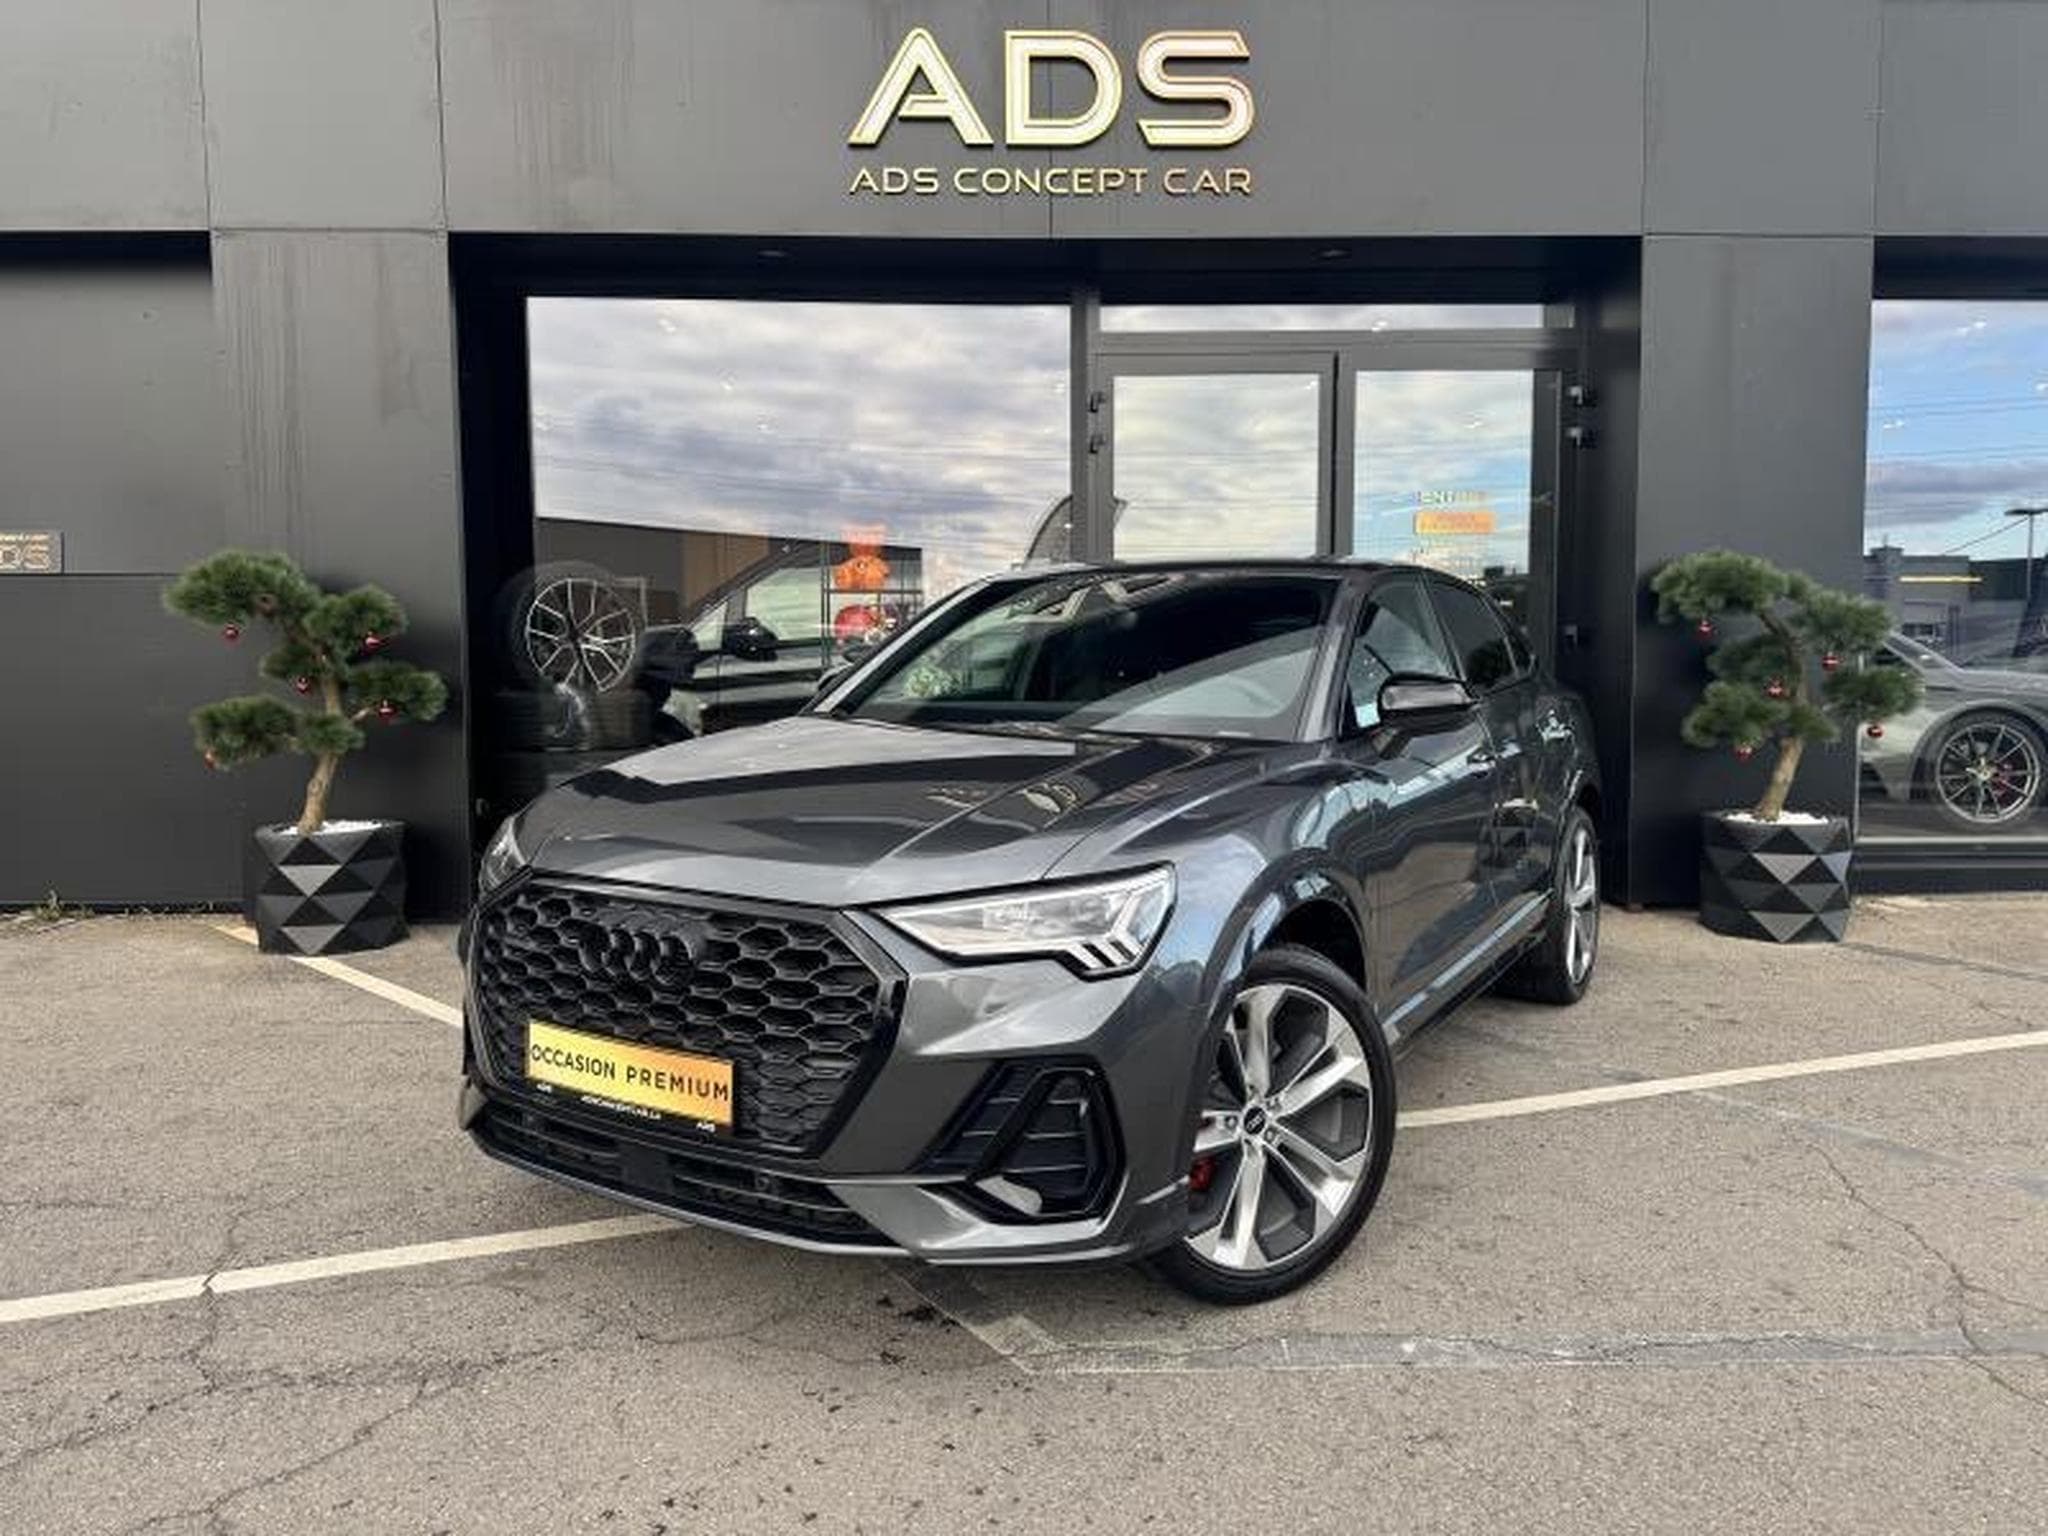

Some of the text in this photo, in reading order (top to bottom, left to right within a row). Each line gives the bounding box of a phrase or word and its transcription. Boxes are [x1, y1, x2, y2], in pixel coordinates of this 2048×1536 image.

[847, 27, 1255, 148] ADS
[849, 167, 1253, 196] ADS CONCEPT CAR
[531, 1043, 729, 1102] OCCASION PREMIUM
